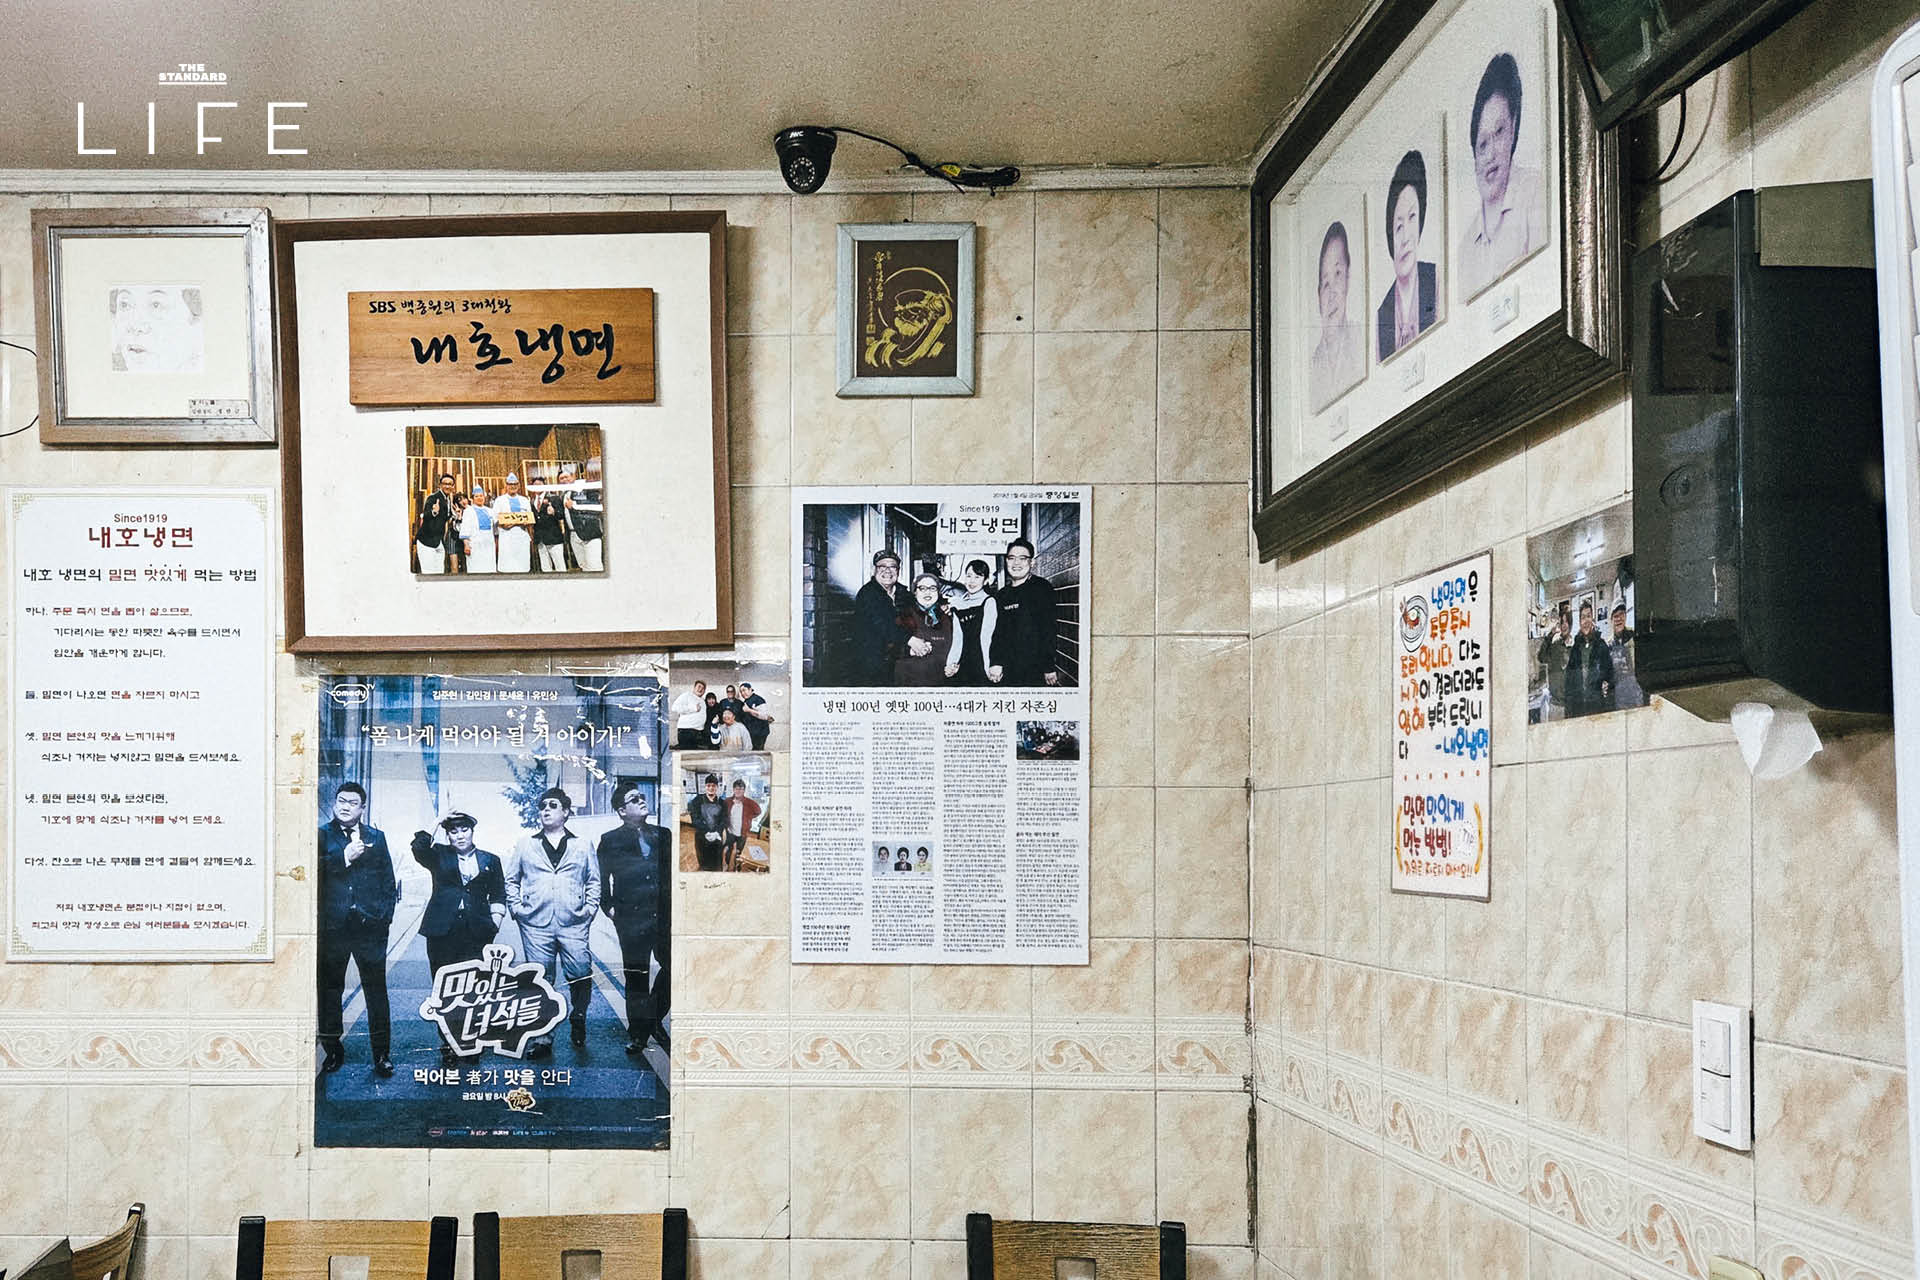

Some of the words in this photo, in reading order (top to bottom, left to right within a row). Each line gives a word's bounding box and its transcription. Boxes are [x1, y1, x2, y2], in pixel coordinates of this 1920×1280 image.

[368, 301, 396, 313] SBS
[400, 300, 456, 315] 백종원의
[462, 300, 512, 314] 3대천왕
[410, 321, 622, 384] 내호냉면
[113, 513, 168, 524] Since1919
[959, 505, 1000, 513] Since1919
[940, 517, 1019, 534] 내호냉면
[88, 526, 193, 549] 내호냉면
[23, 568, 53, 582] 내호
[58, 568, 102, 582] 냉면의
[108, 568, 137, 582] 밀면
[144, 563, 187, 582] 맛있게
[194, 569, 223, 582] 먹는
[229, 569, 257, 582] 방법
[52, 607, 73, 616] 주문
[53, 627, 105, 637] 기다리시는
[201, 628, 241, 638] 드시면서
[1458, 639, 1481, 662] 다소
[823, 700, 847, 714] 냉면
[851, 699, 882, 713] 100년
[885, 699, 910, 714] 옛맛
[992, 699, 1016, 714] 지킨
[1020, 699, 1058, 714] 자존심
[1428, 701, 1447, 732] 부탁
[42, 731, 62, 742] 밀면
[395, 725, 435, 748] 나게
[441, 725, 501, 748] 먹어야
[1398, 740, 1409, 760] 다
[41, 793, 62, 804] 밀면
[1403, 828, 1422, 856] 먹는
[440, 966, 518, 1014] 맛있는
[460, 994, 543, 1041] 녀석들
[414, 1068, 461, 1086] 먹어본
[503, 1068, 536, 1086] 맛을
[541, 1068, 573, 1087] 안다
